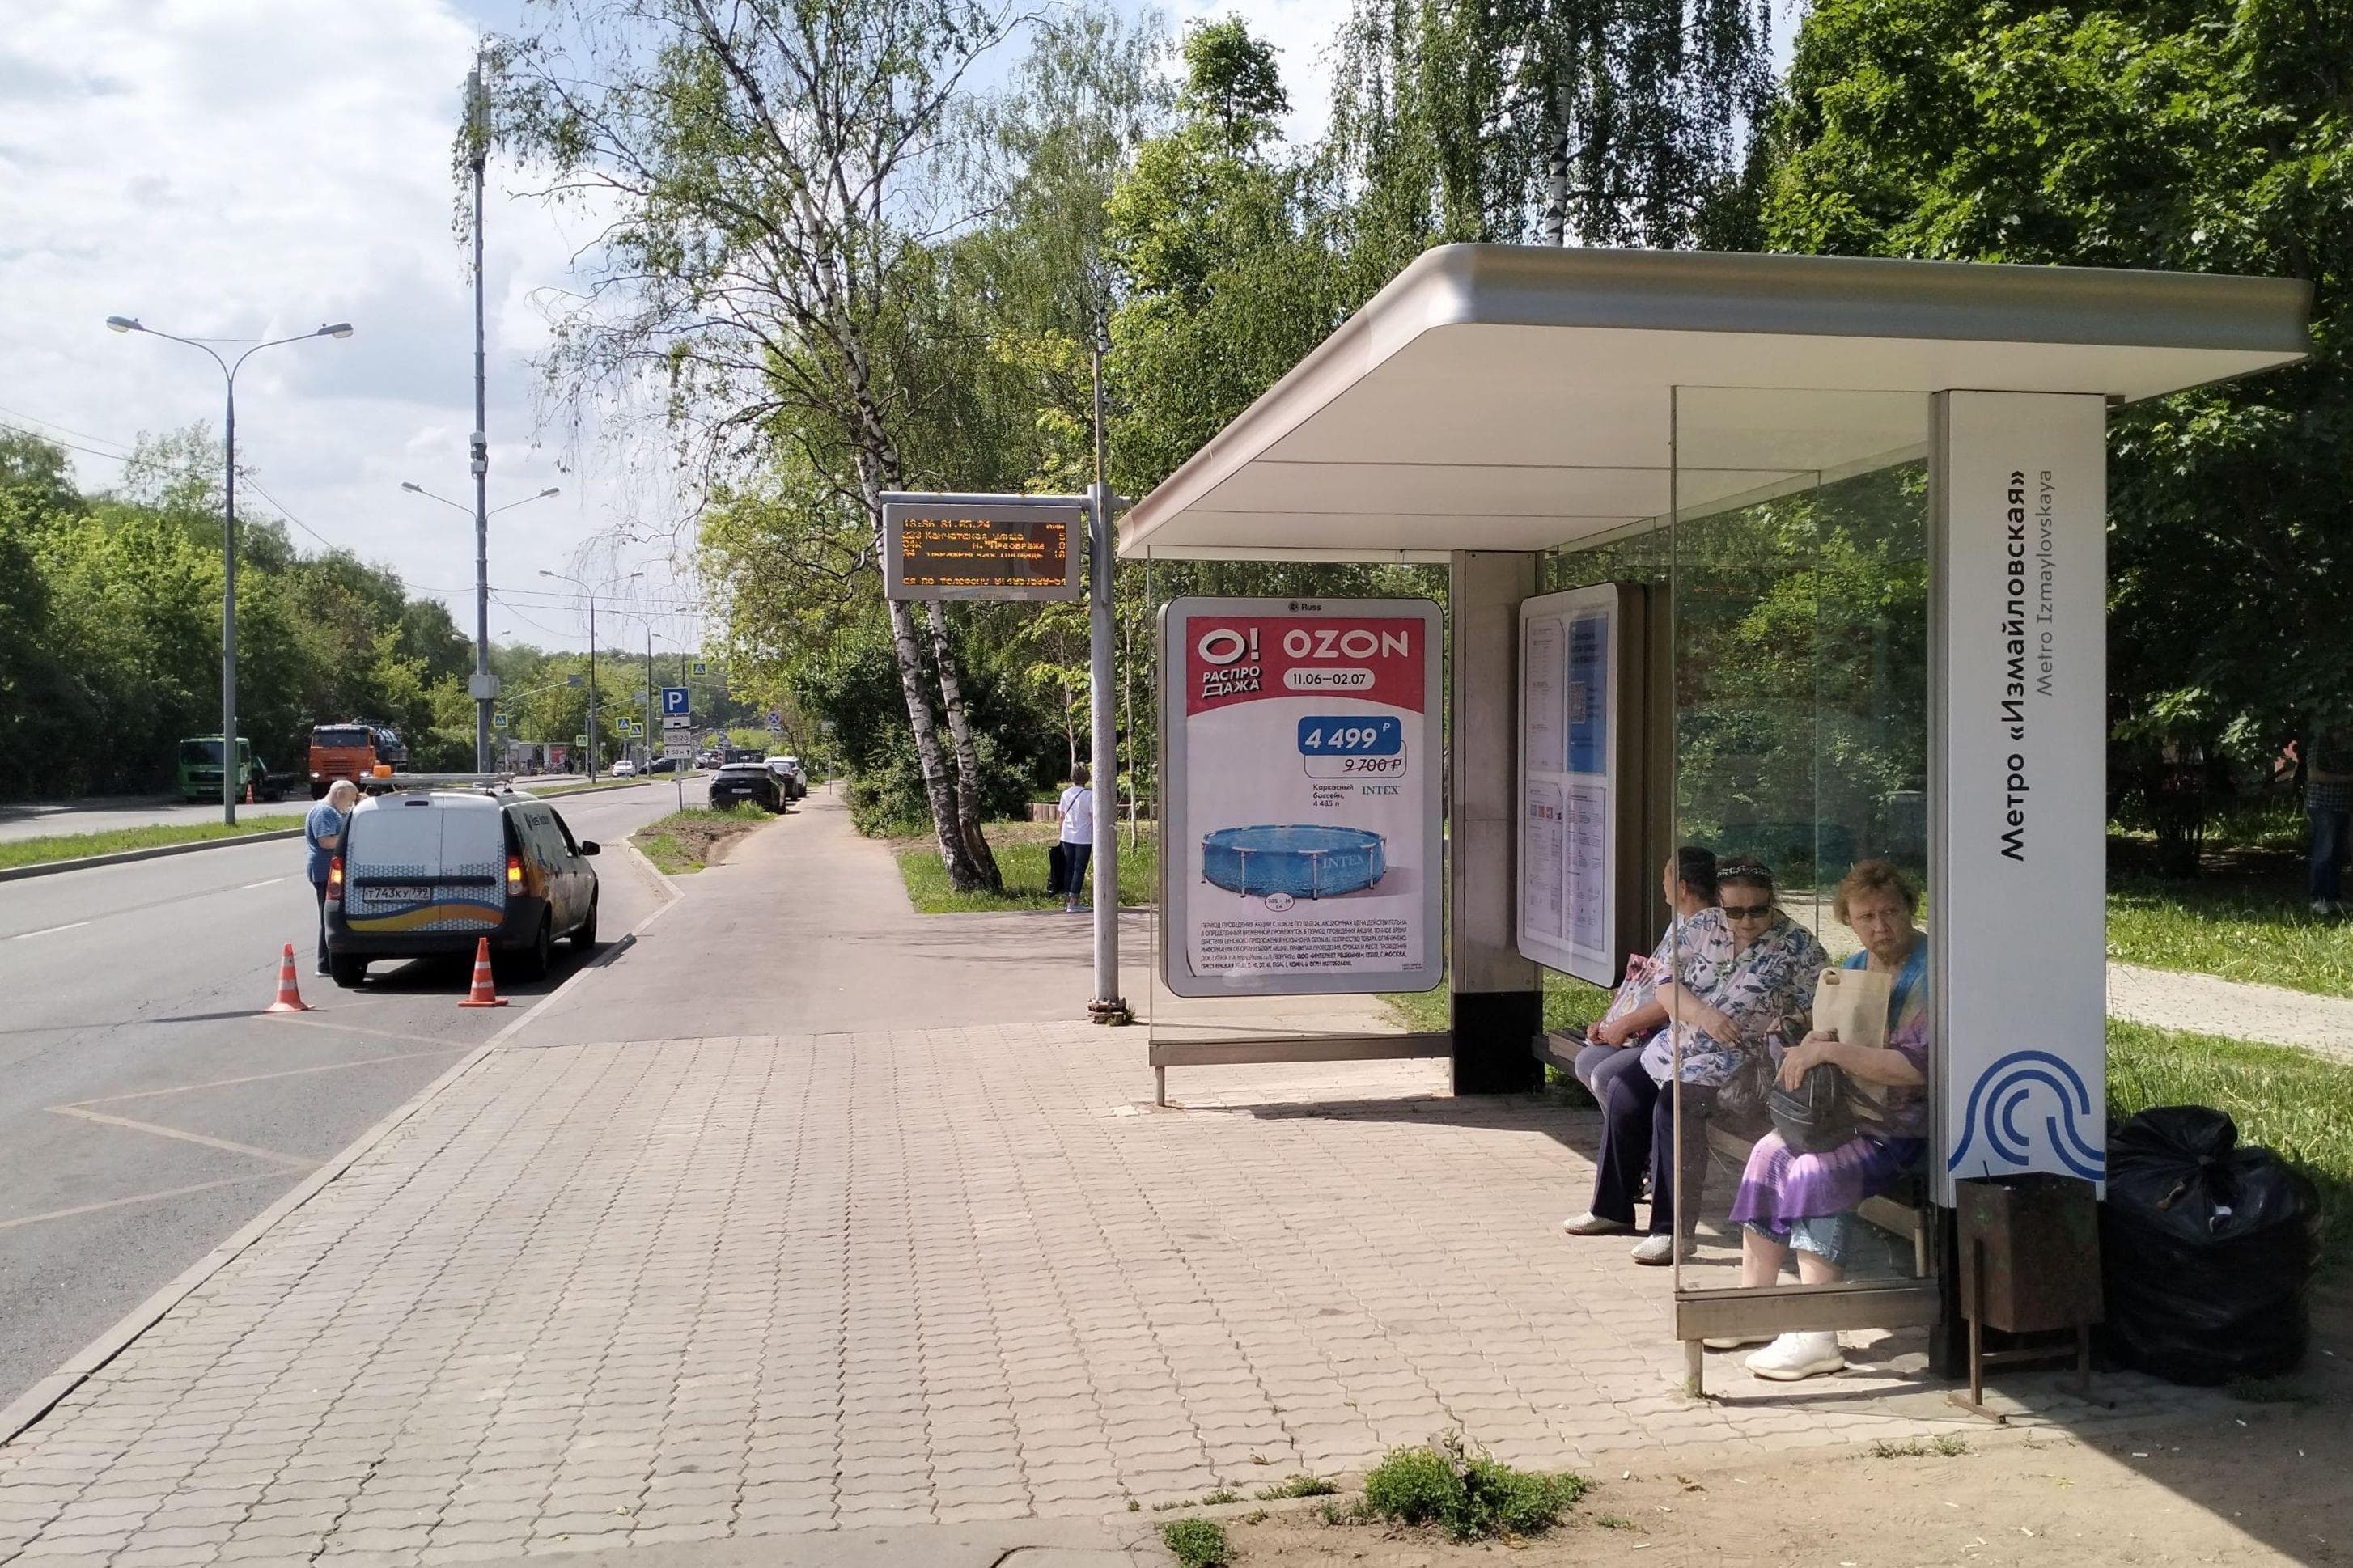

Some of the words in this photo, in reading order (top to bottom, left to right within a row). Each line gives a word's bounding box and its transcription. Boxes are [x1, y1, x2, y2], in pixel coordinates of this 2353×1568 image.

[2035, 469, 2056, 624] Izmaylovskaya
[1301, 603, 1322, 612] Russ
[2000, 470, 2025, 741] «Измайловская»
[1283, 629, 1409, 659] OZON
[2037, 631, 2054, 697] Metro
[1202, 666, 1260, 684] РАСПРО
[1202, 680, 1260, 697] ДАЖА
[668, 692, 683, 711] P
[1312, 783, 1354, 792] Каркасный
[1362, 786, 1400, 795] INTEX
[2000, 753, 2030, 862] Метро
